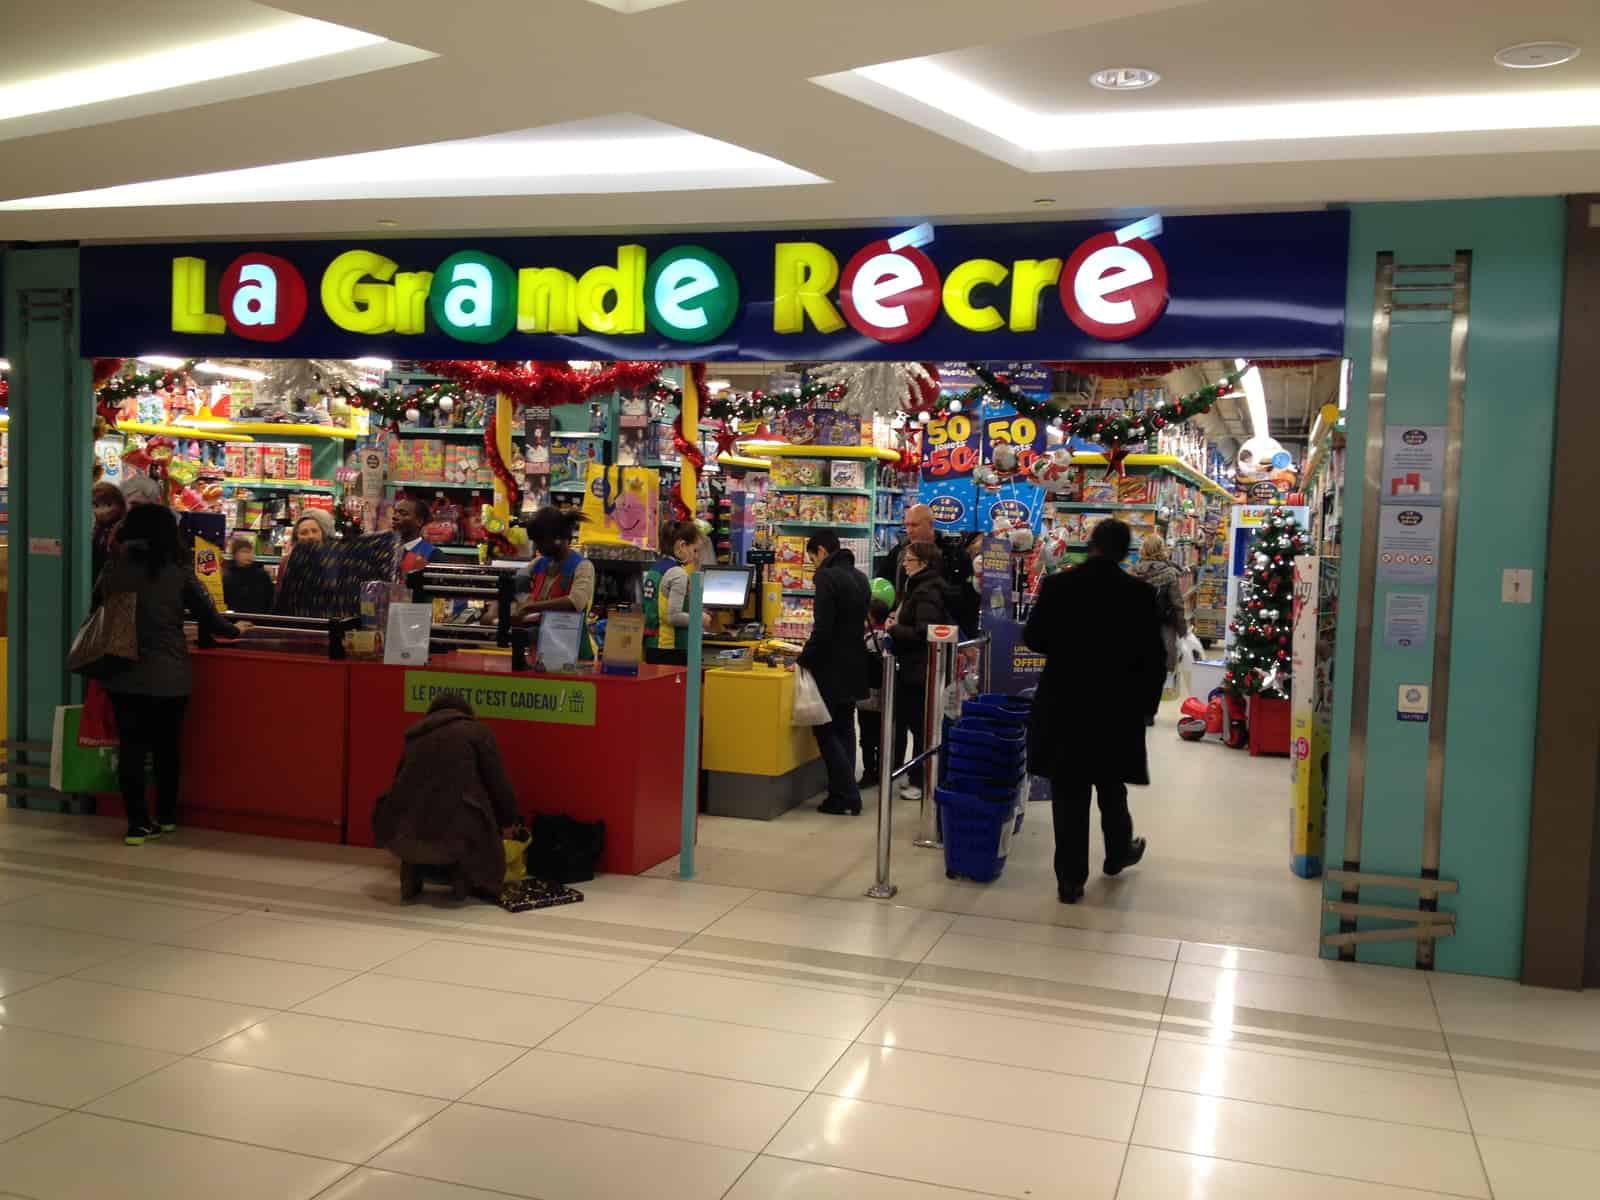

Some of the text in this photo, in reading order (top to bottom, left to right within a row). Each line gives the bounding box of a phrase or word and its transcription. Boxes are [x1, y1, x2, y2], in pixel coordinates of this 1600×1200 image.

[171, 214, 1166, 340] La Grande Récré
[927, 415, 971, 445] 50
[988, 417, 1037, 445] 50
[412, 685, 425, 701] LE
